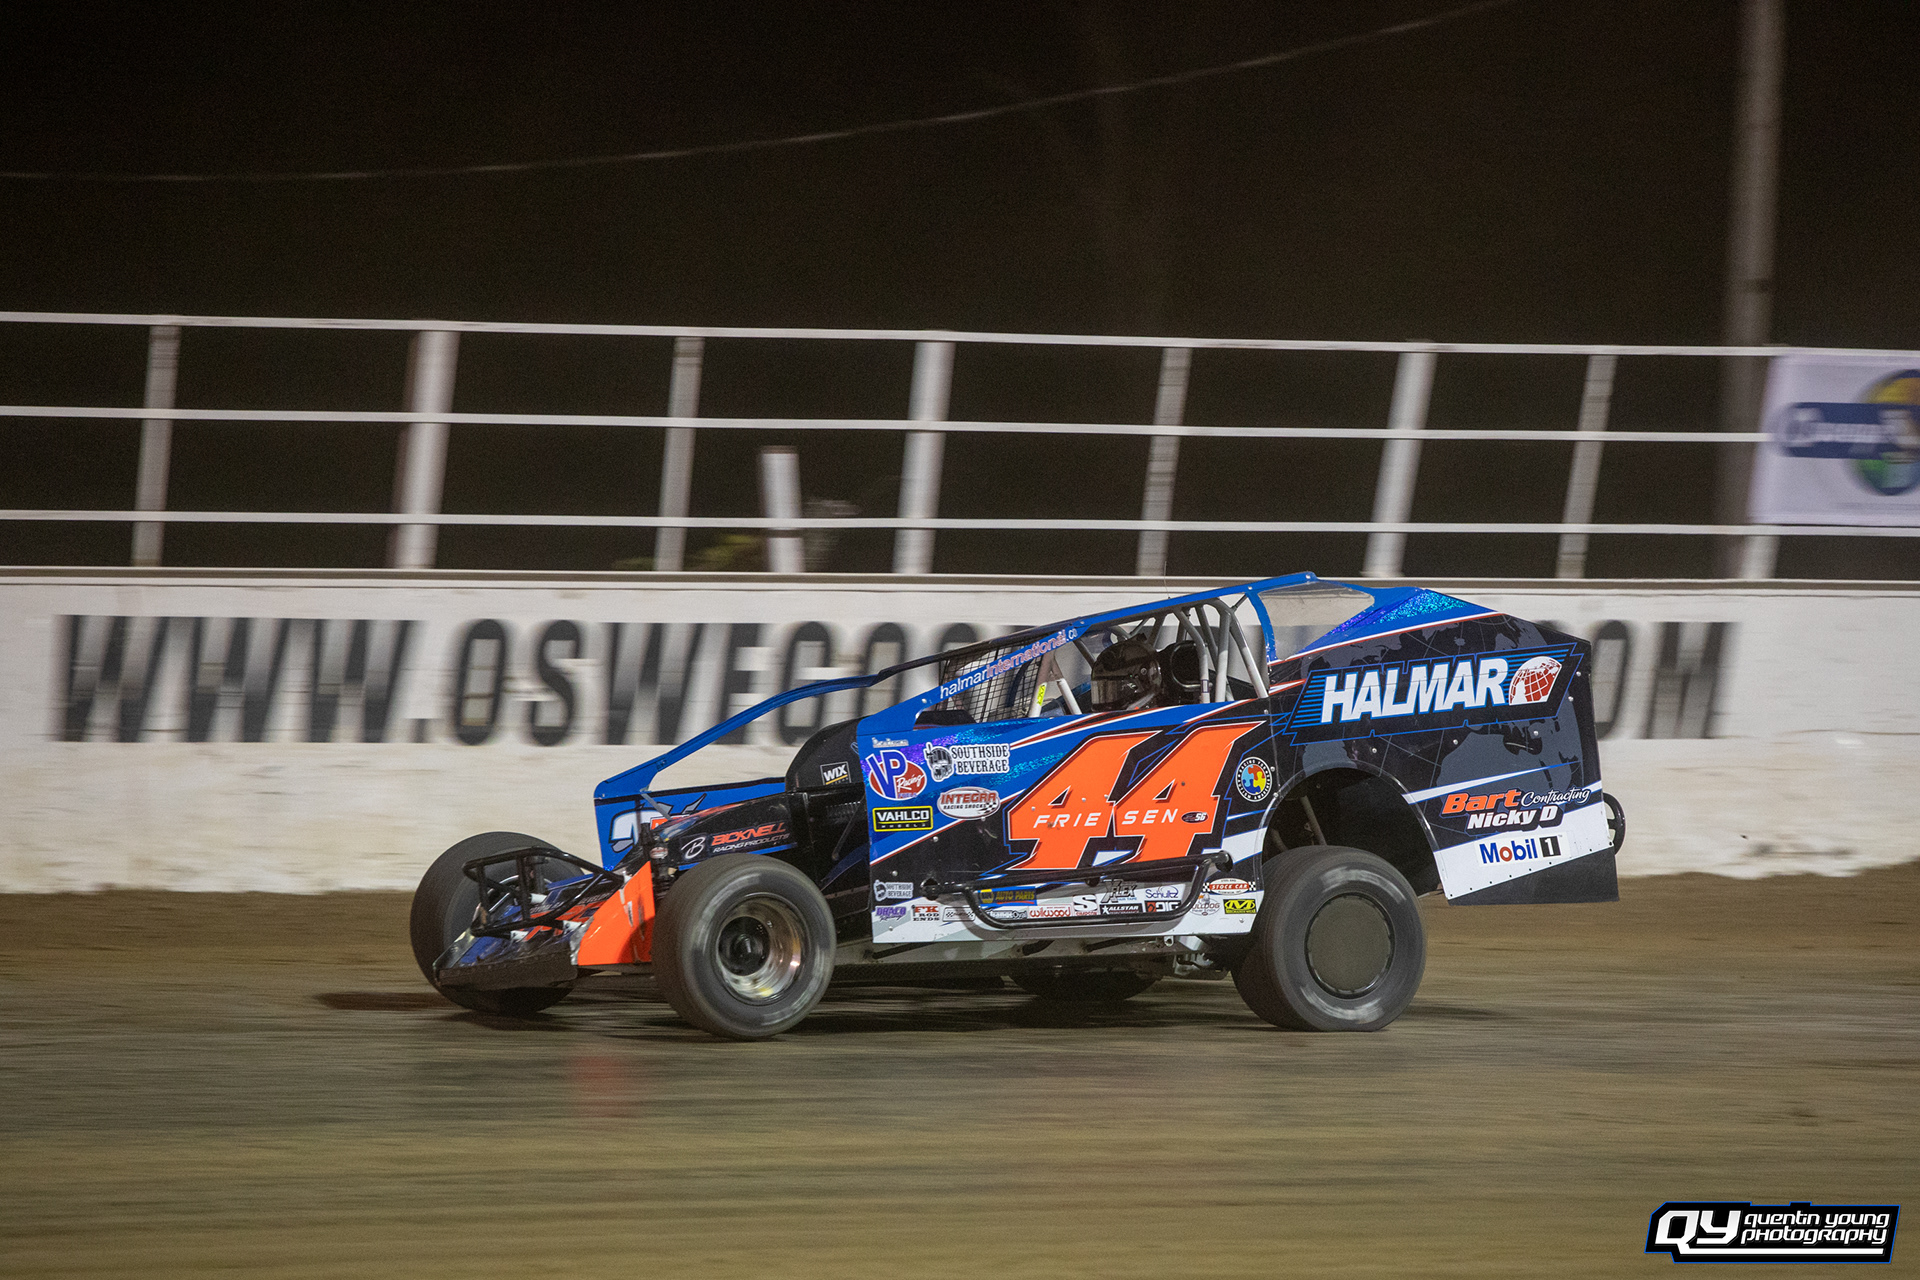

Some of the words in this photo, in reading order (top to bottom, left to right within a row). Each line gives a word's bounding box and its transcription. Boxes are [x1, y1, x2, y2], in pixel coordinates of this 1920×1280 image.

[1590, 619, 1735, 740] OM
[1320, 656, 1509, 723] HALMAR
[950, 744, 1009, 760] SOUTHSIDE
[823, 764, 848, 782] WIX
[865, 749, 908, 800] VP
[896, 773, 925, 793] Racing
[956, 758, 1009, 774] BEVERAGE
[941, 791, 997, 805] INTEGRA
[1004, 720, 1268, 871] 44
[1442, 789, 1521, 815] Bart
[1520, 788, 1591, 807] Contracting
[876, 810, 930, 821] VAHLCO
[1466, 810, 1534, 830] Nicky
[1539, 805, 1560, 821] D
[711, 822, 786, 846] BICKNELL
[713, 840, 744, 853] RACING
[1478, 837, 1539, 864] Mobil
[1542, 836, 1560, 857] 1
[995, 891, 1013, 900] AUTO
[1015, 890, 1035, 900] PARTS
[1145, 885, 1179, 899] Schultz
[1029, 906, 1071, 918] wilwood
